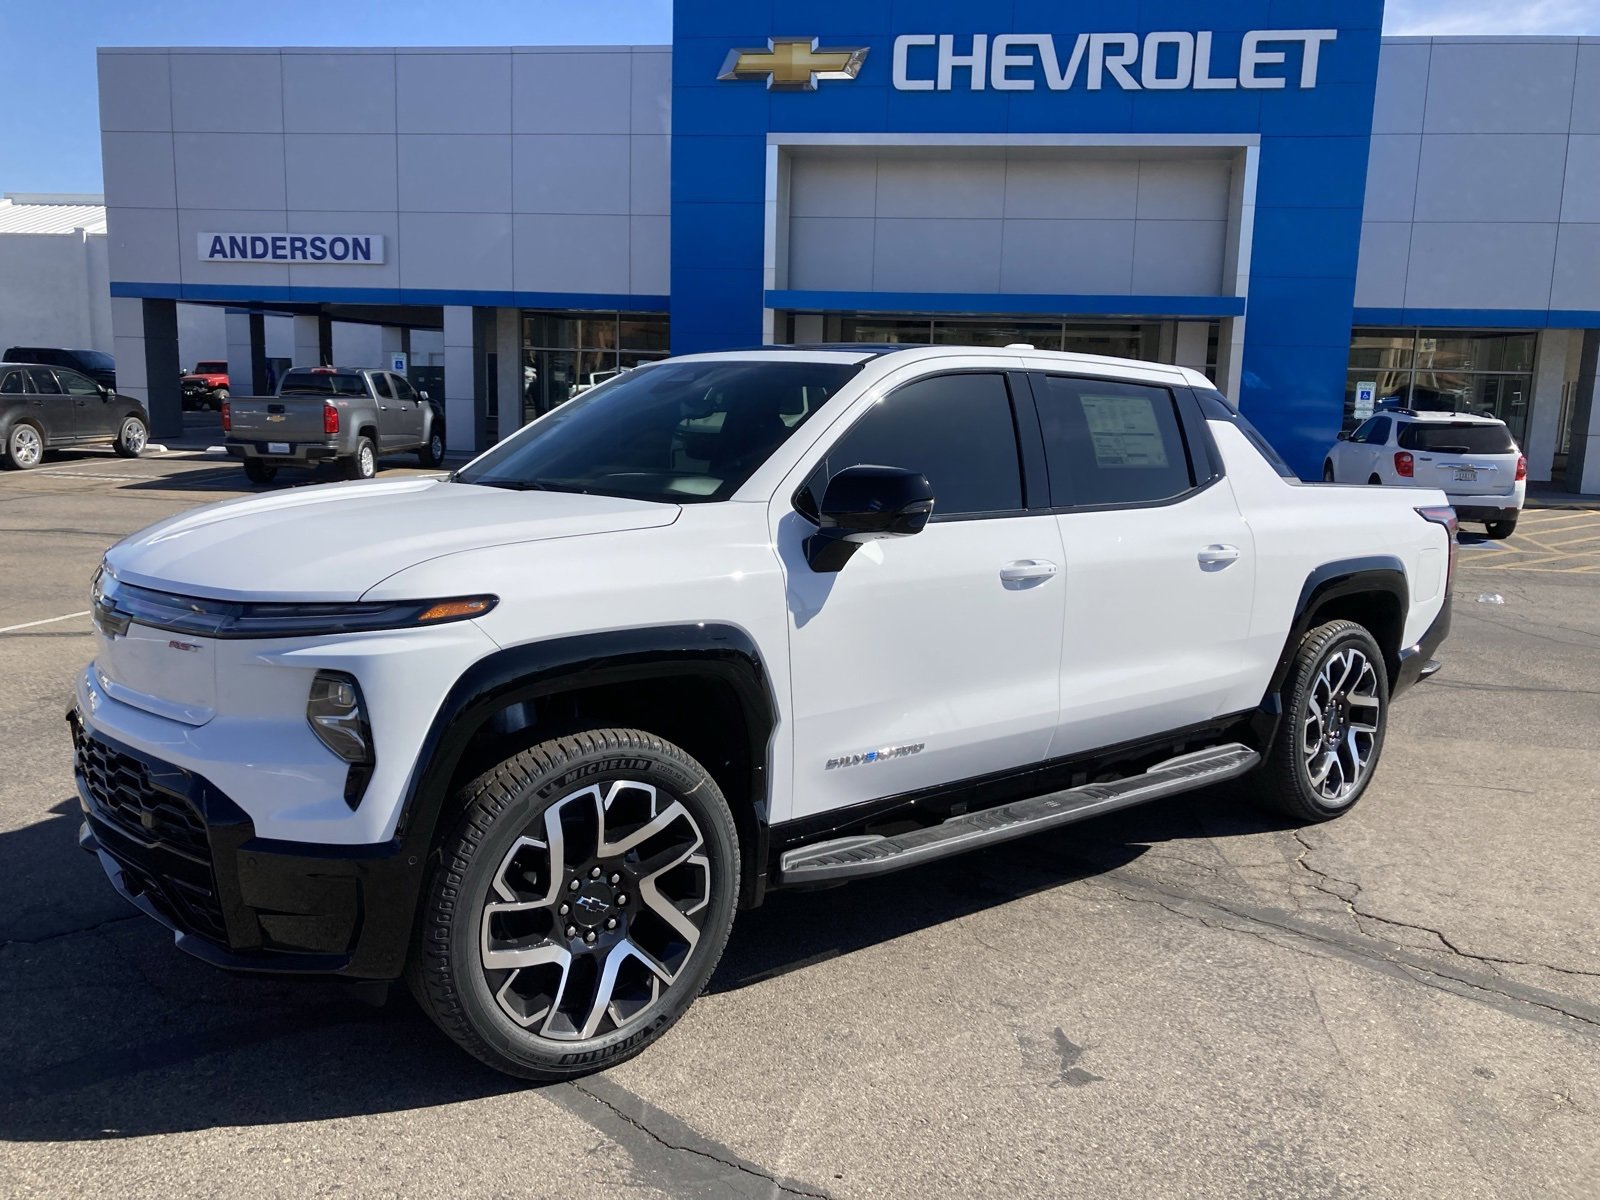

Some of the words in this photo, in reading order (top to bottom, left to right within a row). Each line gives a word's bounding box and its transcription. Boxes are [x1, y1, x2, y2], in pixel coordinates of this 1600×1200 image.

[893, 29, 1338, 91] CHEVROLET
[208, 235, 372, 261] ANDERSON
[563, 759, 649, 785] MICHELIN
